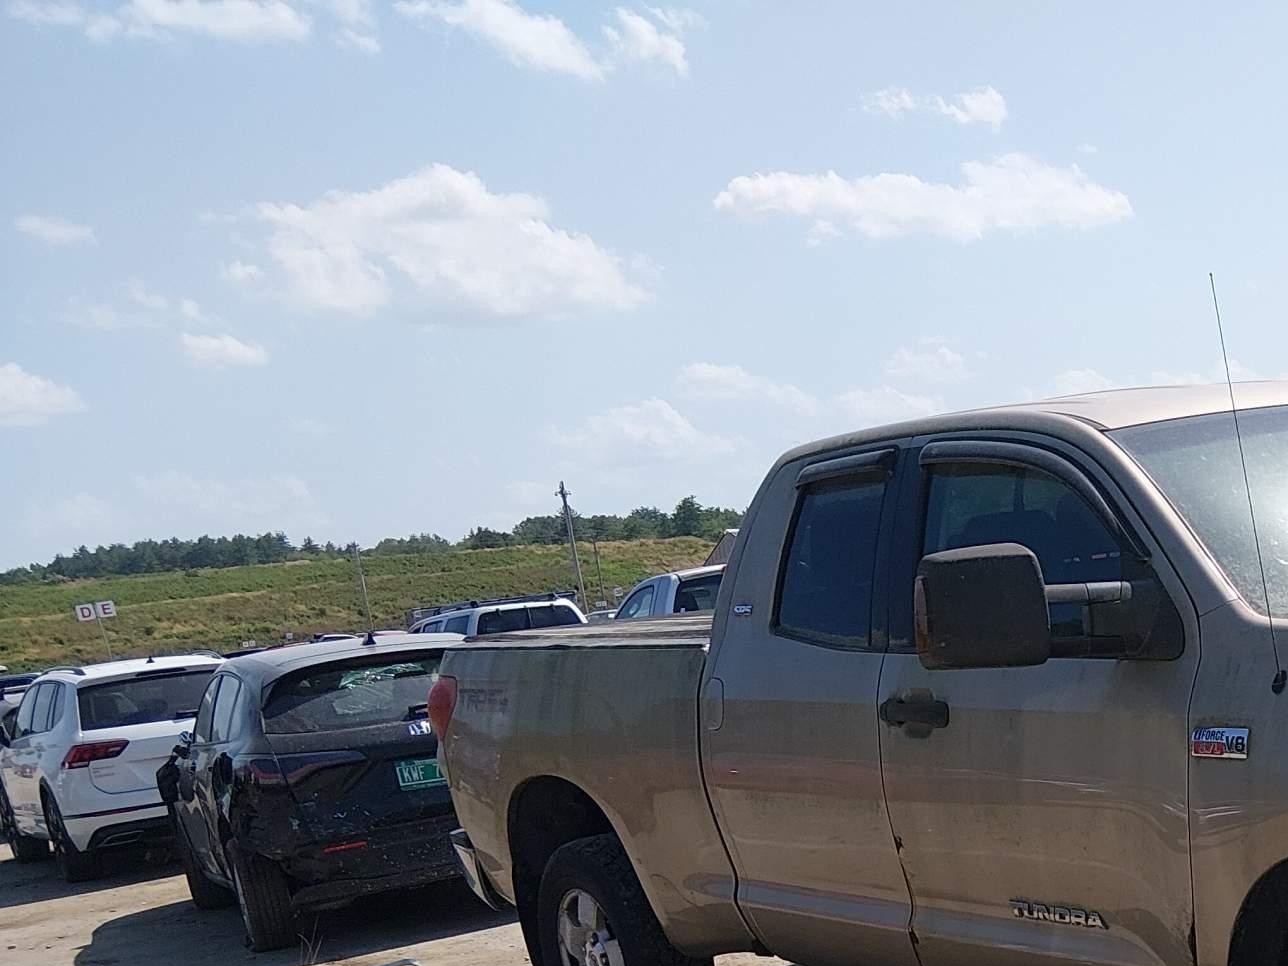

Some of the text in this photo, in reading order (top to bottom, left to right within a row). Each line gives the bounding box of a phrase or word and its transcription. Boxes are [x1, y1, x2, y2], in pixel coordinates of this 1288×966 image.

[80, 604, 112, 618] D E
[1225, 736, 1245, 752] V8
[1008, 899, 1109, 930] TUNDRA
